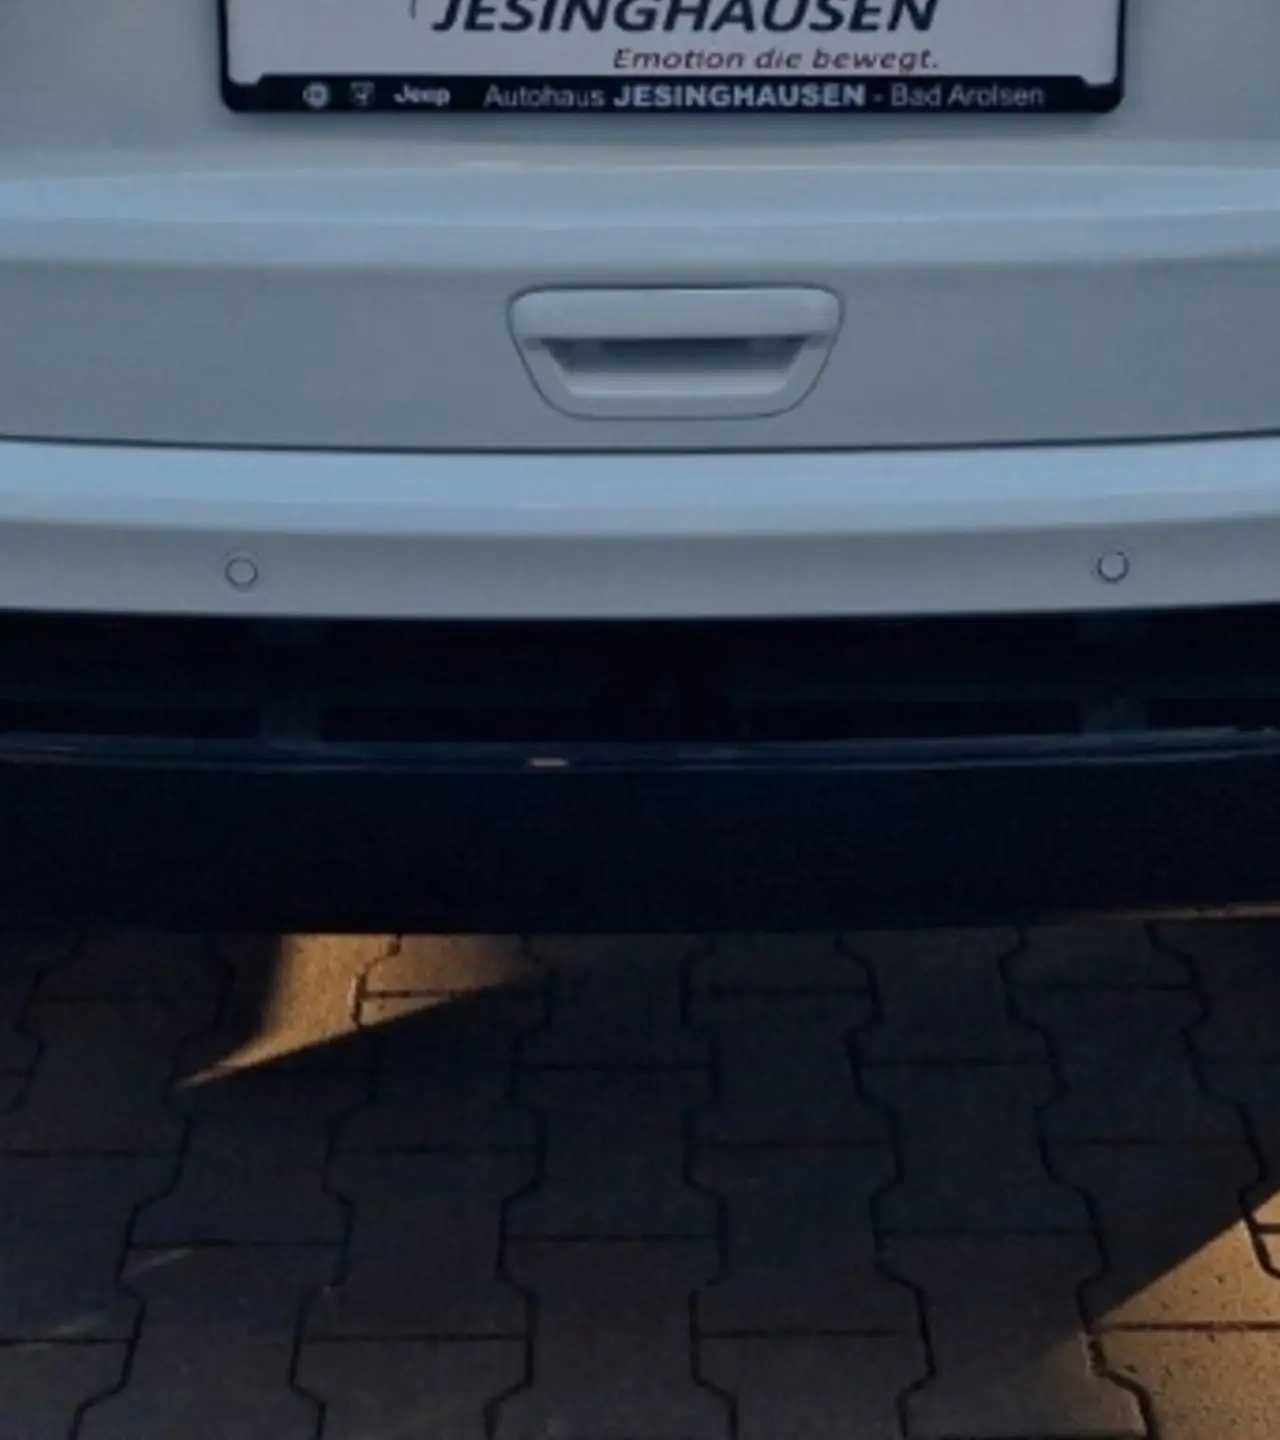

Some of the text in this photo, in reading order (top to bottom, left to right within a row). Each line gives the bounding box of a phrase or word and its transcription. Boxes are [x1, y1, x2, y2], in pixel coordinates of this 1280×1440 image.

[612, 47, 939, 75] Emotion die bewegt.
[392, 83, 451, 108] Jeep
[482, 83, 605, 108] Autohaus
[613, 84, 866, 108] JESINGHAUSEN
[890, 84, 942, 107] Bad
[947, 84, 1046, 107] Arolsen
